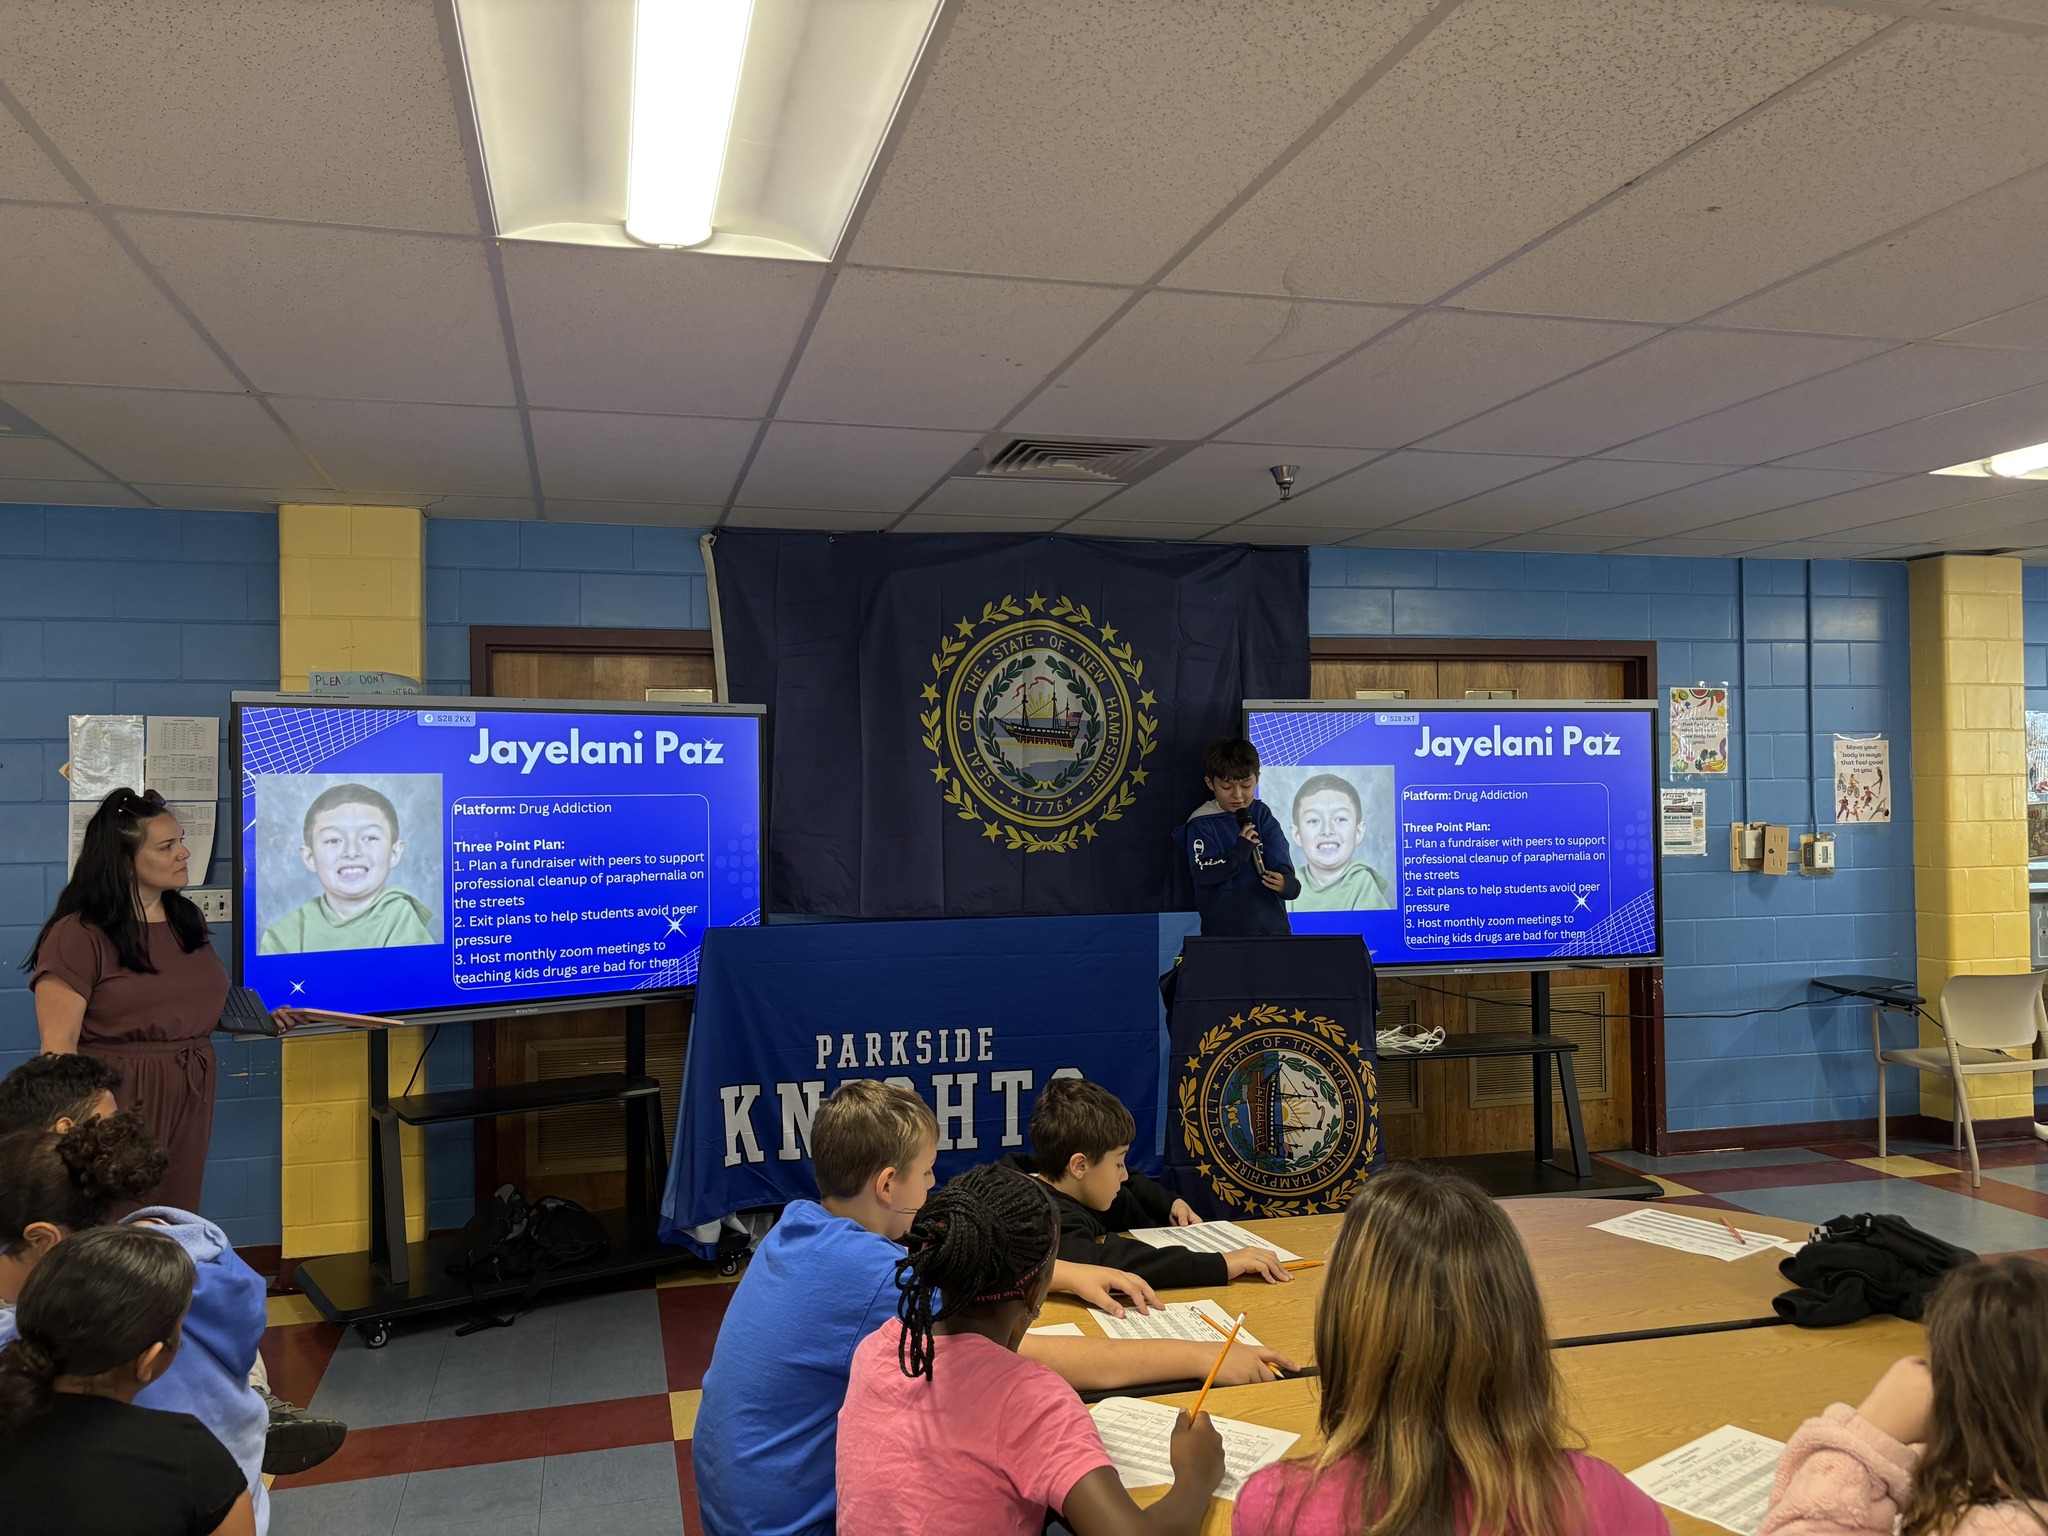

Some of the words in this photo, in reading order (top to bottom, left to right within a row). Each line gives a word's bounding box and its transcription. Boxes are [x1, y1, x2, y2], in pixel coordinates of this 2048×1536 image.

[992, 634, 1034, 660] STATE
[1050, 635, 1067, 650] OF
[1077, 652, 1107, 683] NEW
[964, 664, 987, 694] THE
[959, 710, 972, 732] OF
[469, 728, 643, 774] Jayelani
[656, 730, 724, 764] Paz
[1089, 696, 1120, 789] HAMPSHIRE
[1414, 725, 1553, 765] Jayelani
[1563, 726, 1621, 756] Paz
[967, 746, 995, 787] SEAL
[1404, 791, 1451, 801] Platform:
[1454, 790, 1478, 802] Drug
[1480, 789, 1528, 800] Addiction
[454, 803, 516, 815] Platform:
[519, 803, 550, 816] Drug
[552, 802, 612, 814] Addiction
[1026, 800, 1064, 814] 1776
[1404, 822, 1433, 833] Three
[1436, 822, 1463, 833] Point
[1466, 822, 1490, 832] Plan:
[454, 841, 492, 852] Three
[496, 840, 530, 851] Point
[533, 840, 565, 851] Plan:
[1404, 839, 1412, 849] 1.
[1415, 839, 1436, 848] Plan
[1448, 837, 1500, 848] fundraiser
[1502, 836, 1522, 846] with
[1525, 837, 1552, 848] peers
[1555, 837, 1565, 846] to
[1568, 836, 1606, 848] support
[454, 861, 465, 872] 1.
[469, 860, 497, 871] Plan
[500, 861, 508, 870] a
[511, 856, 575, 870] fundraiser
[579, 855, 605, 867] with
[608, 856, 641, 869] peers
[644, 854, 656, 864] to
[659, 852, 705, 866] support
[1405, 853, 1467, 866] professional
[1470, 852, 1508, 865] cleanup
[1511, 852, 1522, 862] of
[1524, 851, 1591, 864] paraphernalia
[1593, 852, 1605, 861] on
[455, 876, 534, 892] professional
[538, 874, 587, 888] cleanup
[590, 872, 603, 884] of
[606, 869, 687, 886] paraphernalia
[690, 870, 704, 880] on
[1405, 870, 1422, 880] the
[1424, 870, 1460, 880] streets
[1405, 887, 1414, 897] 2.
[1416, 886, 1435, 896] Exit
[1438, 885, 1464, 898] plans
[1467, 885, 1478, 895] to
[1480, 884, 1502, 896] help
[1504, 882, 1547, 894] students
[1550, 882, 1576, 892] avoid
[1579, 883, 1600, 893] peer
[455, 897, 476, 909] the
[479, 896, 525, 908] streets
[1406, 902, 1450, 914] pressure
[455, 917, 466, 928] 2.
[470, 915, 494, 927] Exit
[497, 914, 531, 928] plans
[534, 912, 548, 924] to
[551, 910, 578, 925] help
[581, 907, 634, 920] students
[637, 905, 669, 917] avoid
[672, 904, 698, 916] peer
[1406, 918, 1415, 929] 3.
[1417, 918, 1441, 928] Host
[1444, 916, 1486, 928] monthly
[1488, 916, 1514, 926] zoom
[1517, 914, 1562, 926] meetings
[1564, 914, 1574, 924] to
[455, 934, 512, 949] pressure
[1406, 933, 1450, 946] teaching
[1452, 932, 1472, 943] kids
[1475, 931, 1502, 943] drugs
[1505, 932, 1521, 941] are
[1523, 930, 1541, 940] bad
[1544, 929, 1558, 939] for
[1560, 928, 1586, 939] them
[455, 954, 467, 966] 3.
[470, 952, 500, 965] Host
[504, 947, 557, 963] monthly
[560, 947, 593, 958] zoom
[596, 941, 650, 958] meetings
[653, 940, 666, 951] to
[455, 969, 511, 984] teaching
[514, 967, 539, 980] kids
[543, 963, 578, 979] drugs
[580, 963, 600, 974] are
[603, 960, 625, 972] bad
[628, 958, 646, 970] for
[649, 956, 679, 968] them
[815, 1027, 994, 1070] PARKSIDE
[1262, 1037, 1281, 1047] OF
[1293, 1039, 1320, 1057] THE
[1223, 1044, 1254, 1070] SEAL
[1326, 1062, 1355, 1105] STATE
[720, 1067, 1084, 1168] KNHT
[1208, 1098, 1222, 1137] 1776
[1344, 1121, 1356, 1140] OF
[1232, 1160, 1312, 1188] HAMPSHIRE
[1318, 1150, 1346, 1178] NEW
